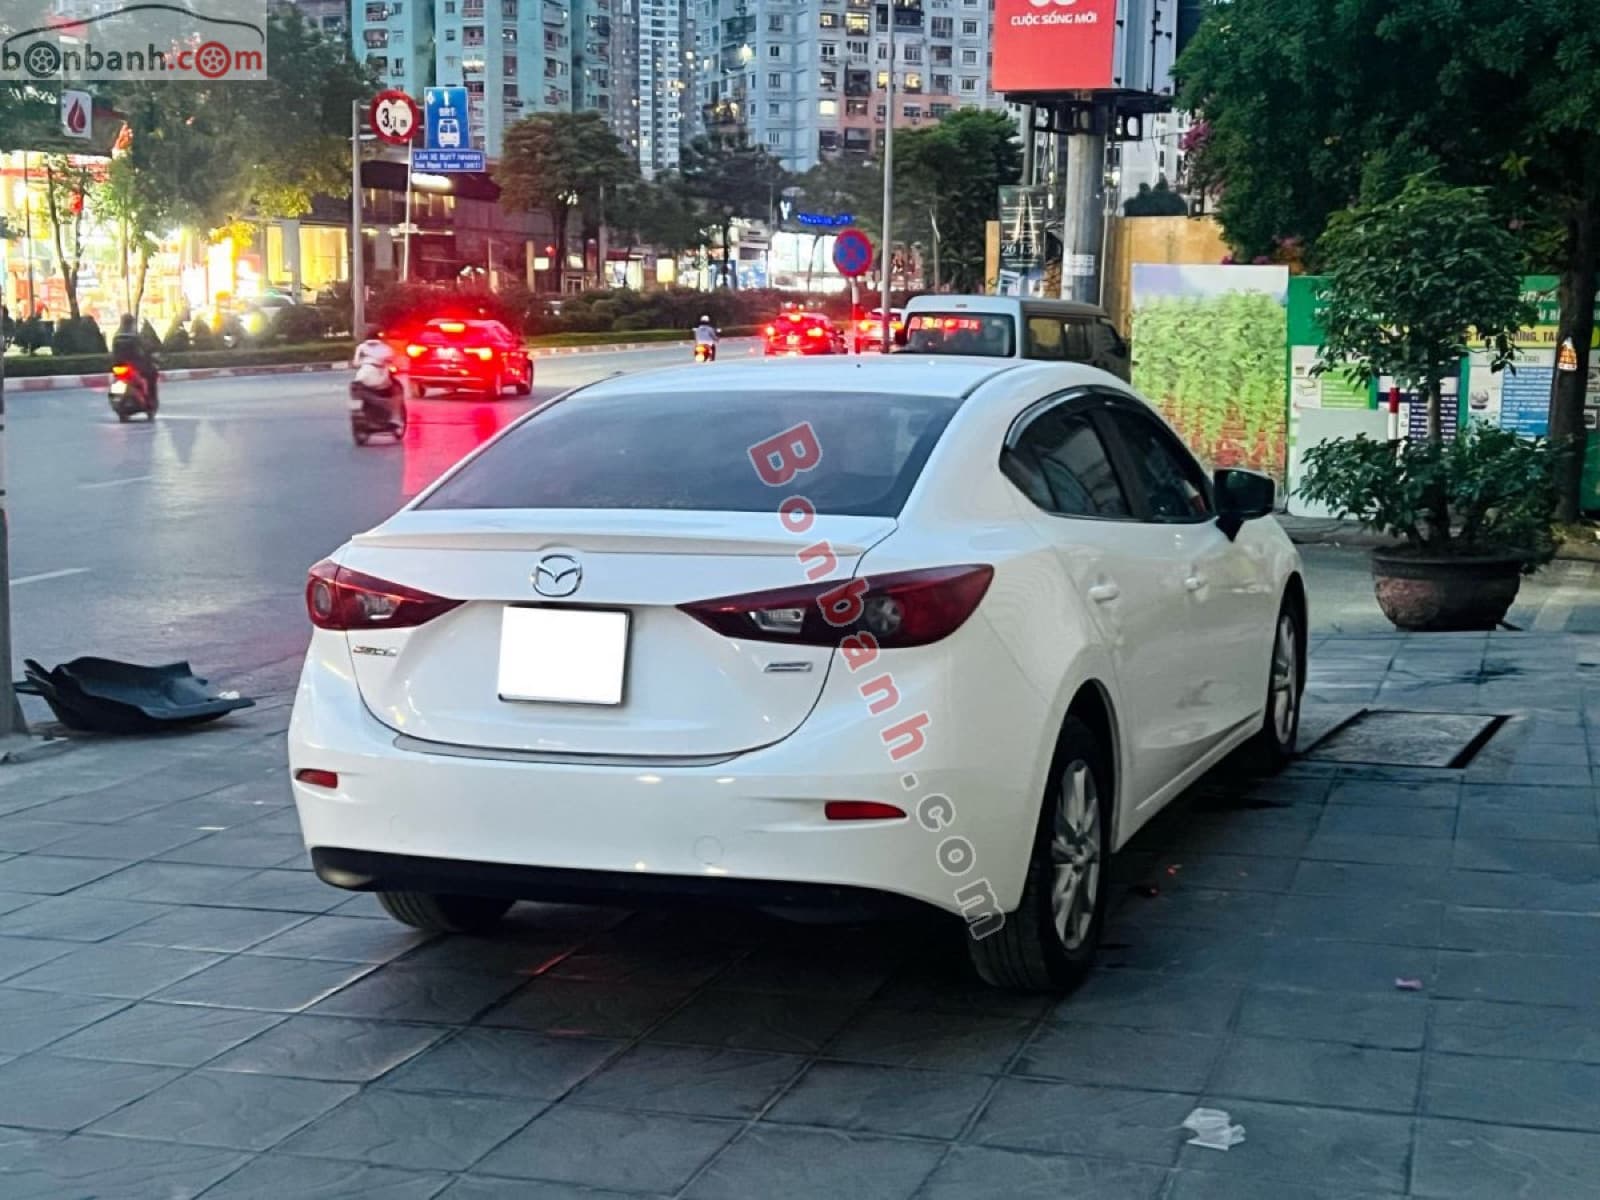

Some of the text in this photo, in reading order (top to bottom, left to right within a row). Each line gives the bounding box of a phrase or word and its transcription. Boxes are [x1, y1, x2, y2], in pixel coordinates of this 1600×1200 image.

[1011, 10, 1097, 26] CUỘC SỐNG MỚI
